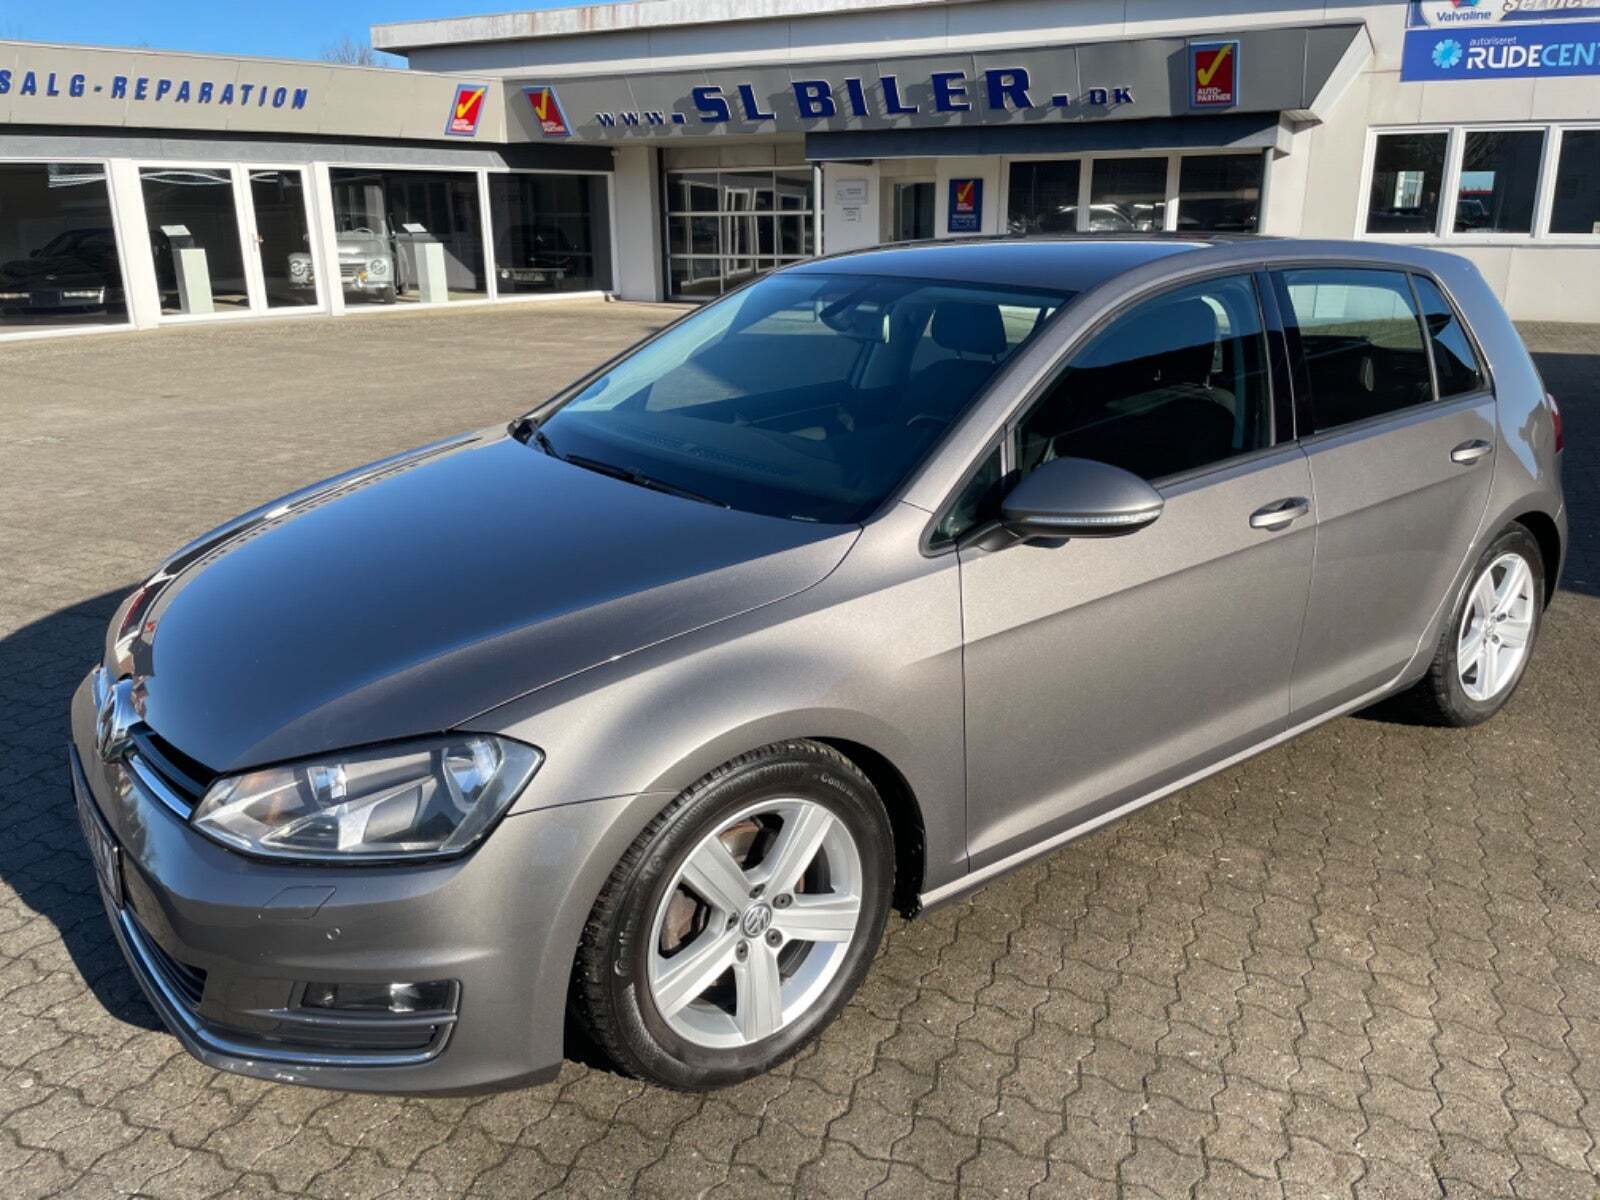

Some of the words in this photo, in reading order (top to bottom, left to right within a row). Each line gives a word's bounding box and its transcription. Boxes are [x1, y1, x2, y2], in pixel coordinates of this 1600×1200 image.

[1436, 10, 1491, 22] Valvoline
[1469, 36, 1517, 47] autoriseret
[1466, 42, 1600, 69] RUDECEN
